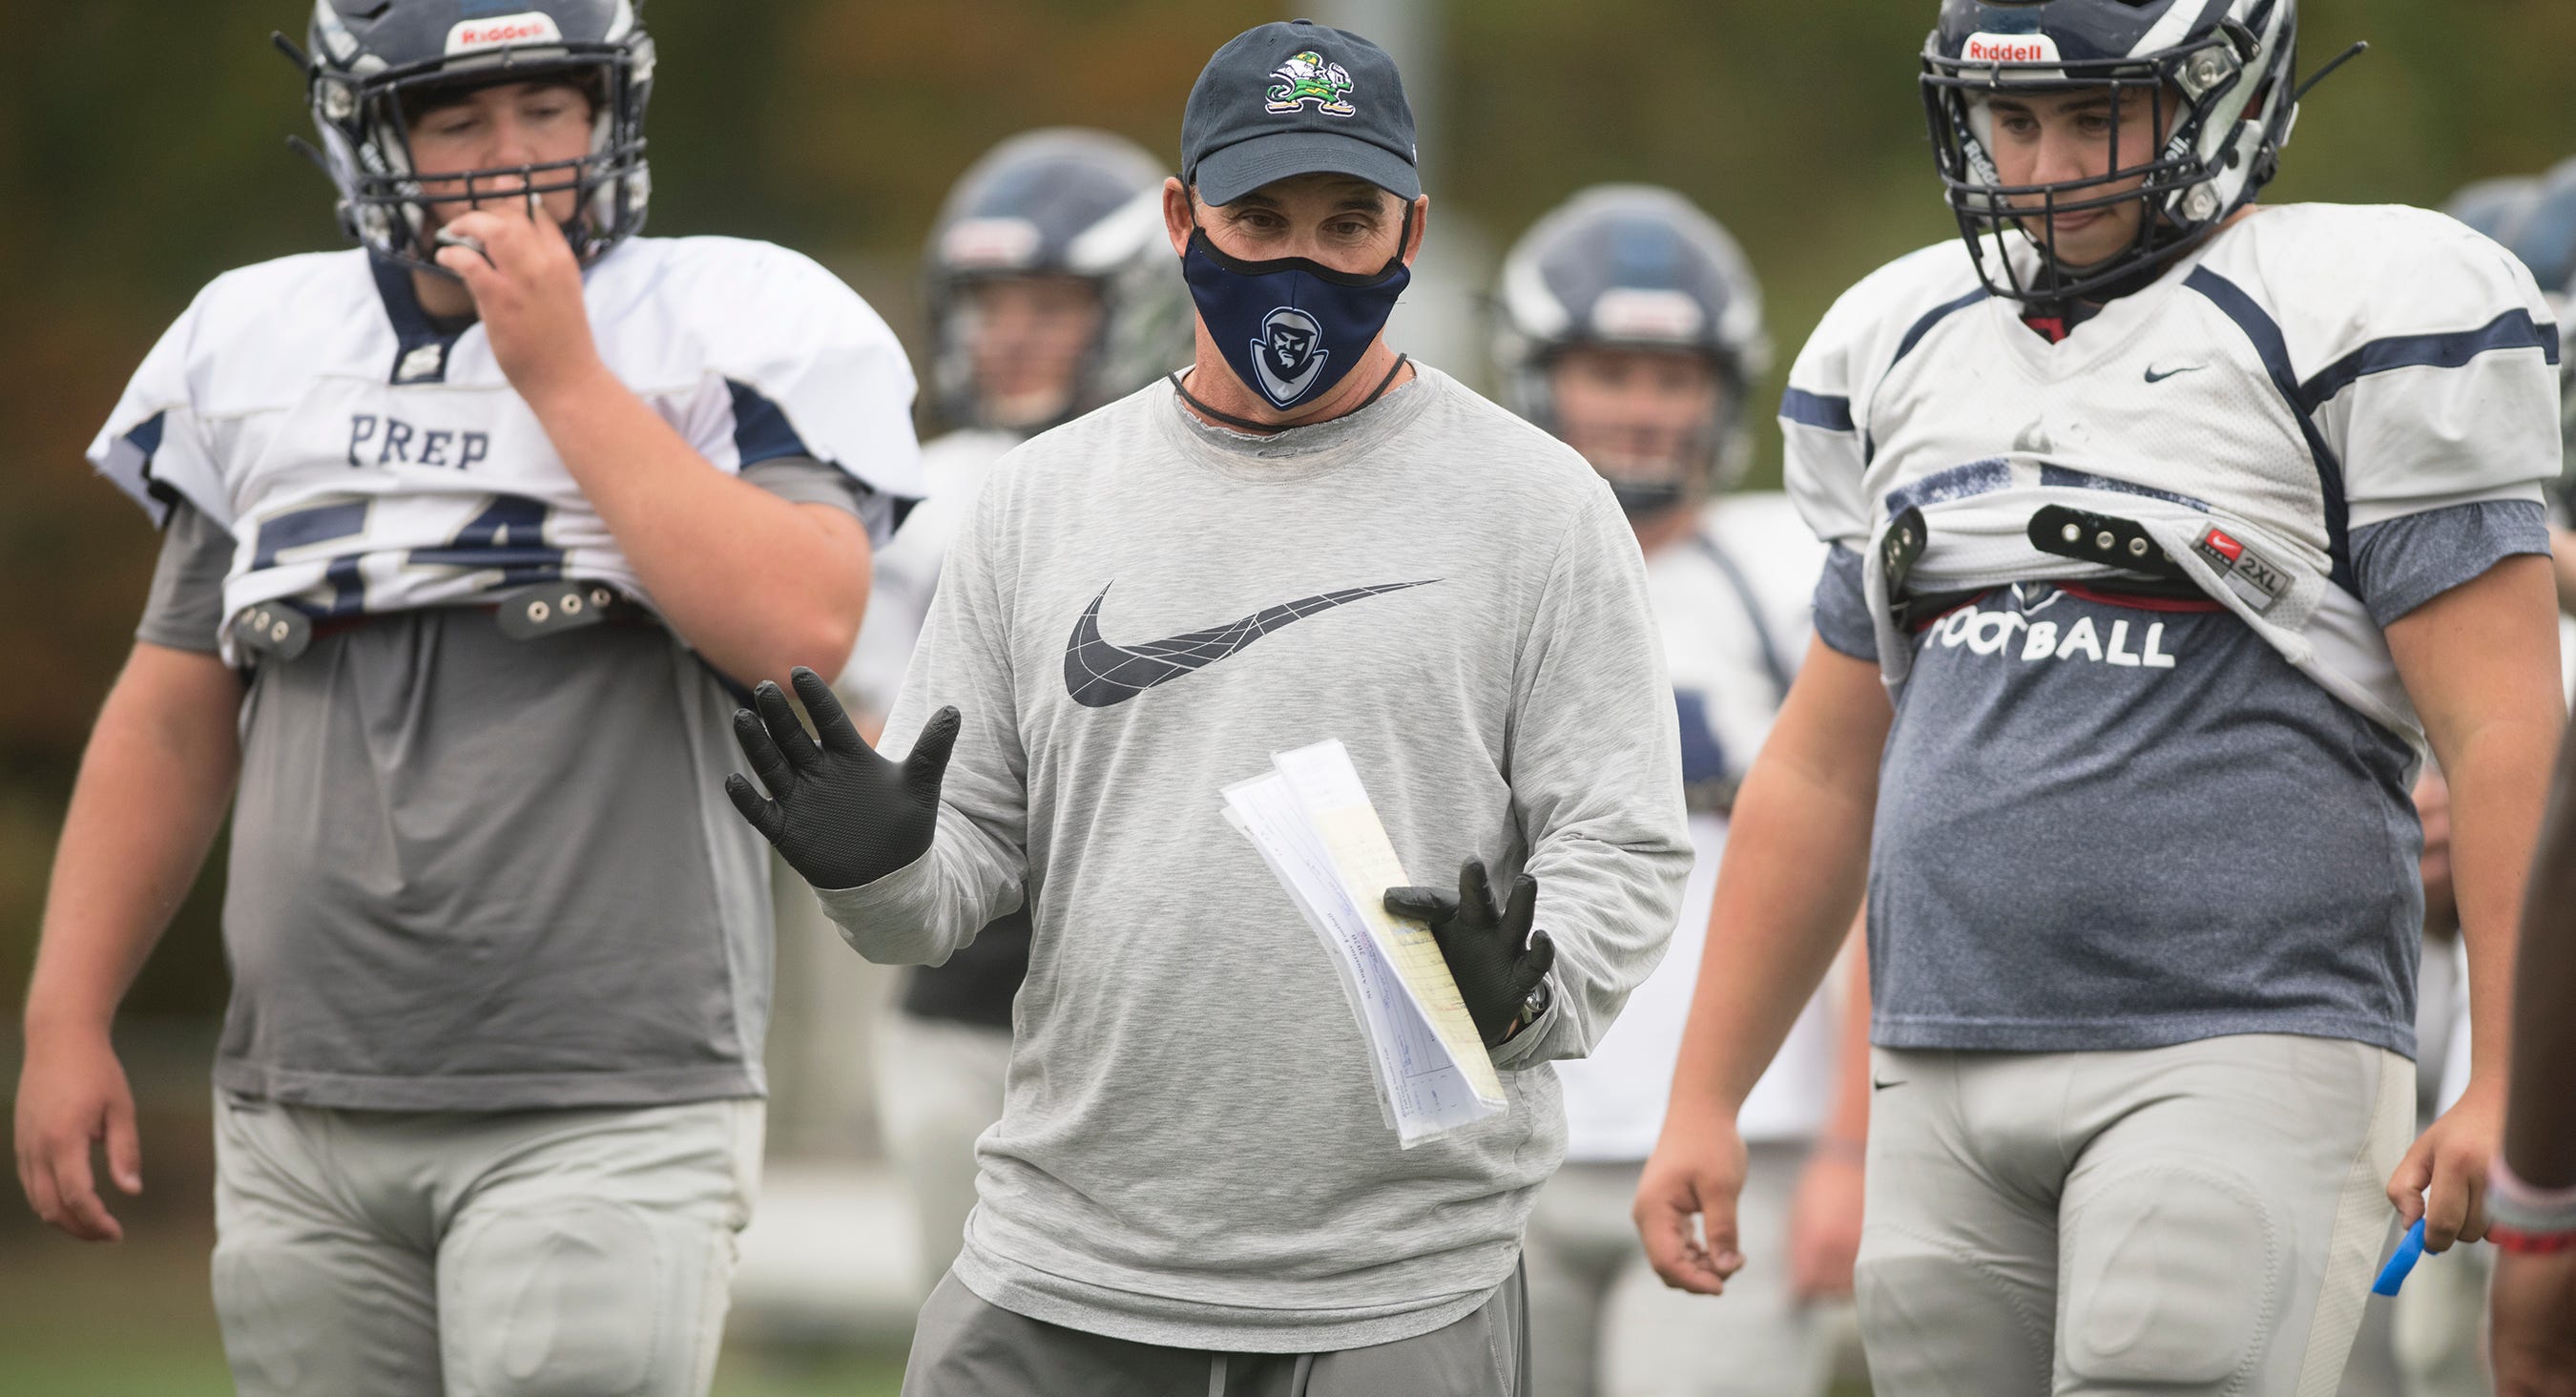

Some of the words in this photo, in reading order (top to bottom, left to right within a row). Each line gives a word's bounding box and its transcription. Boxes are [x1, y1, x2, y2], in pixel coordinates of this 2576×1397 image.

[1970, 41, 2042, 61] Riddell
[348, 413, 489, 470] PREP
[2238, 556, 2278, 592] 2XL
